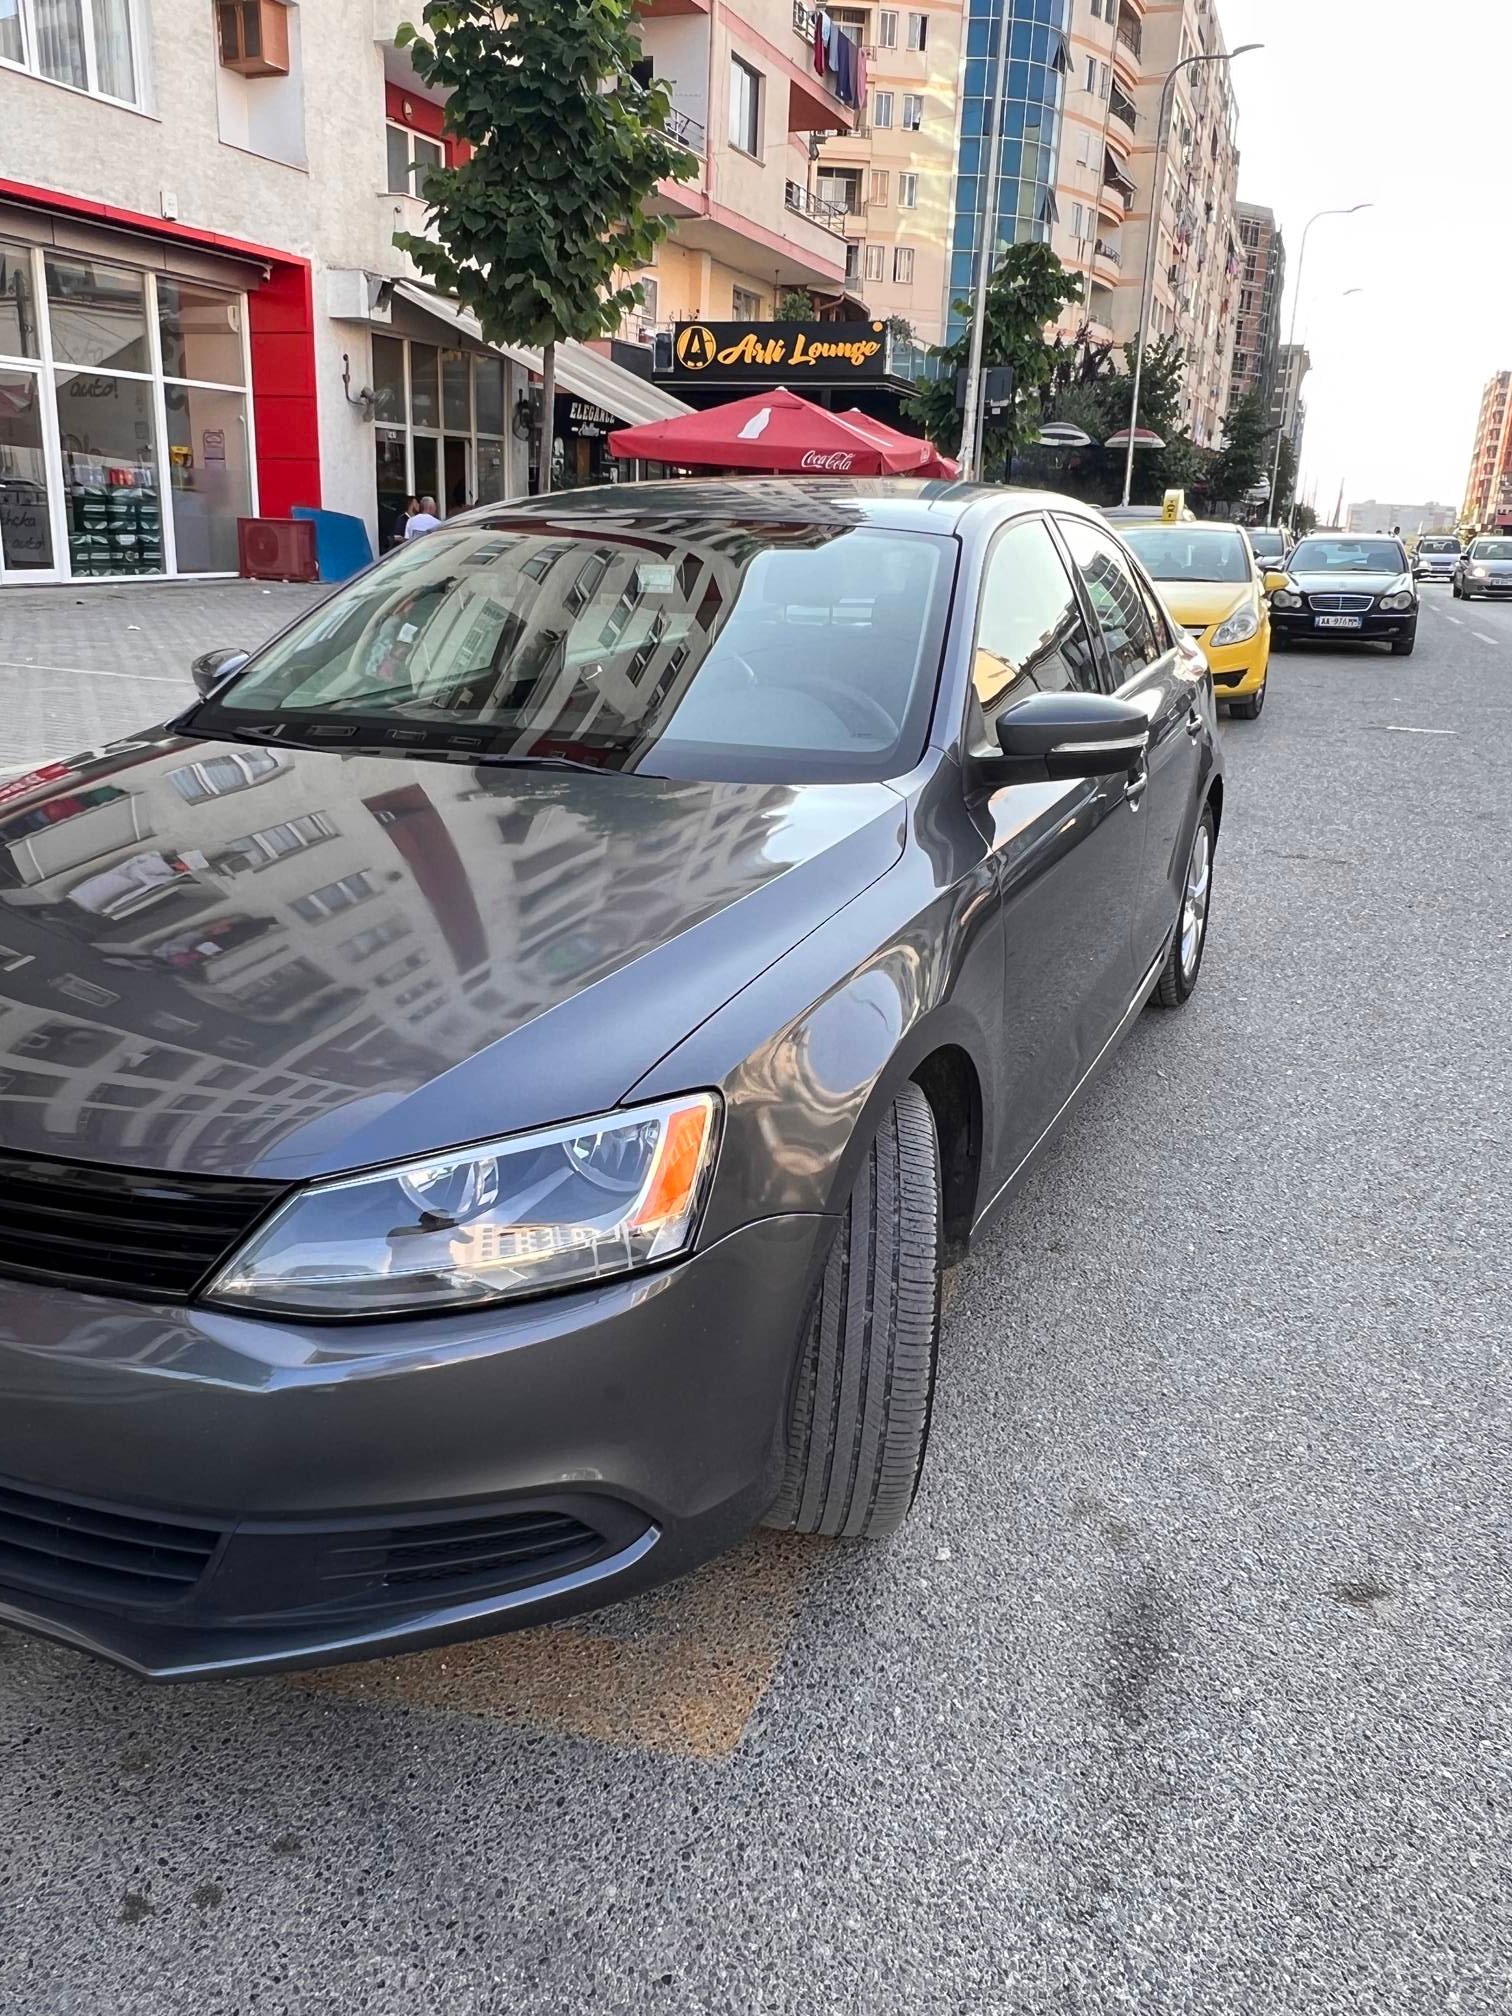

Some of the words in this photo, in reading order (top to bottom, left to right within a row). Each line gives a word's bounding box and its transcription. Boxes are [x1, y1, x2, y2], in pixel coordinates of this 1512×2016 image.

[717, 333, 786, 366] Arli
[788, 333, 881, 366] Lounge
[70, 378, 119, 399] auto!
